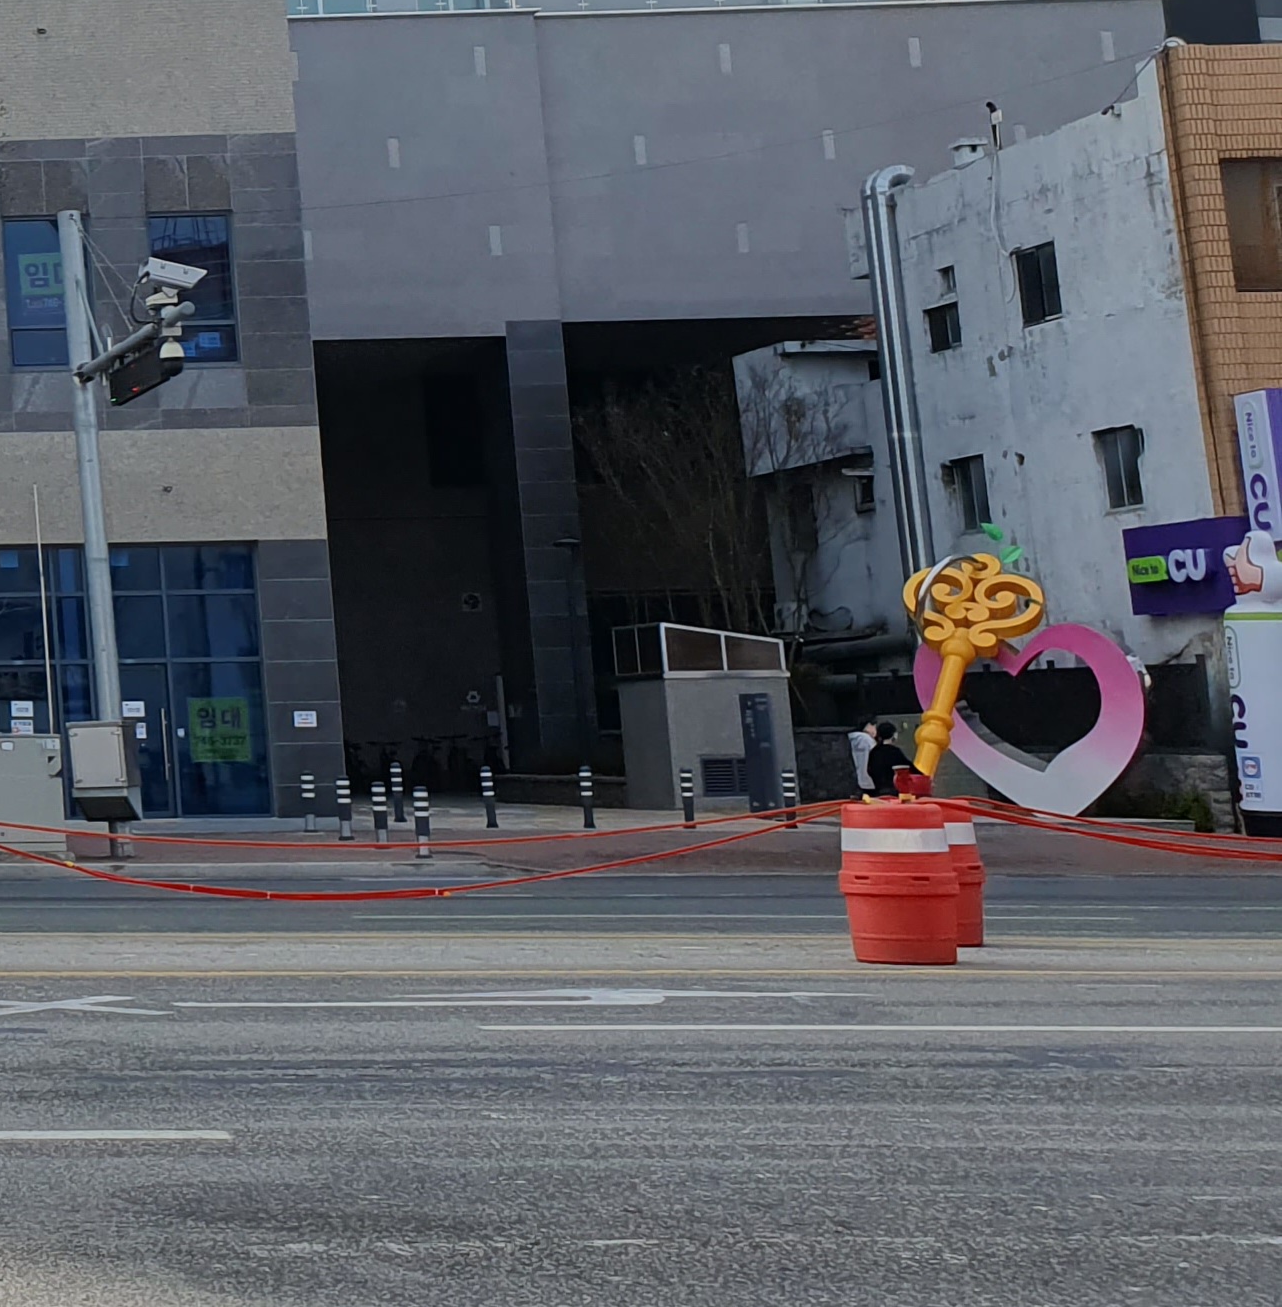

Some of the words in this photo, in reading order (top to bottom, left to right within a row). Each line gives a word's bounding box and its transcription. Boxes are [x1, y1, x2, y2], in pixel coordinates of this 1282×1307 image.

[1244, 412, 1255, 442] Nice
[1249, 473, 1272, 530] CU
[1167, 547, 1206, 583] CU
[196, 707, 242, 729] 임대
